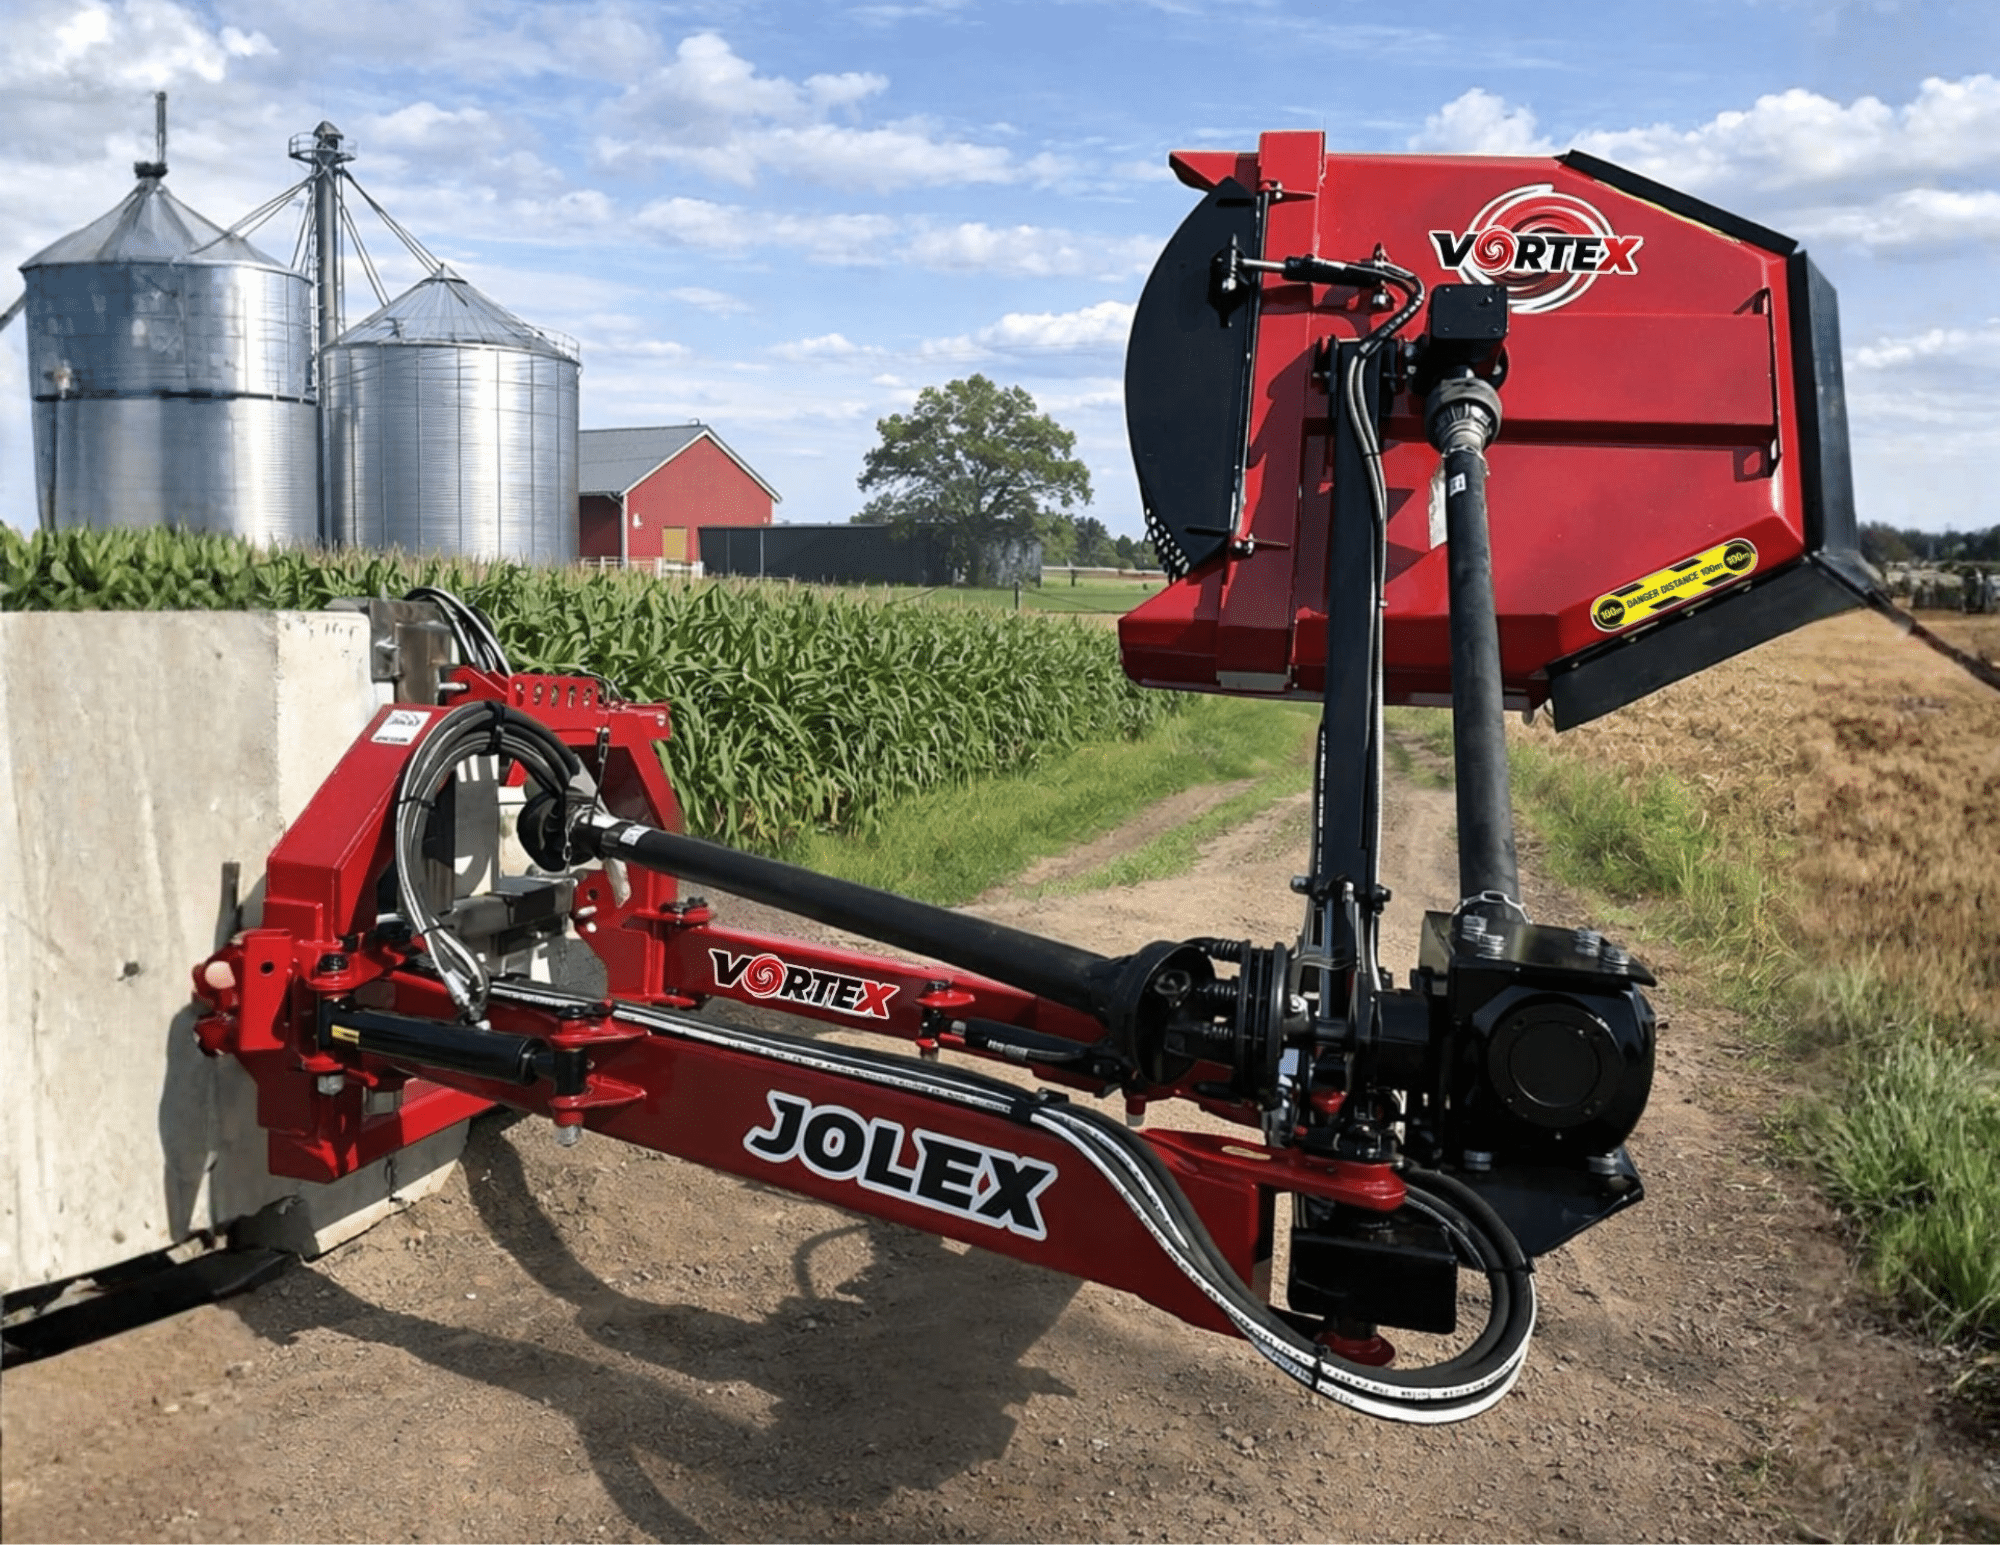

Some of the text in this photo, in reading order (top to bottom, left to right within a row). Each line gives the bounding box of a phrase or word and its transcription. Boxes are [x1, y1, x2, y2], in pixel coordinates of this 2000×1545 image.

[1430, 225, 1643, 275] VORTEX
[1726, 552, 1750, 565] 100m
[1626, 563, 1723, 608] DANGER DISTANCE 100m
[1600, 607, 1624, 619] 100m
[708, 948, 900, 1020] VORTEX
[745, 1091, 1056, 1240] JOLEX
